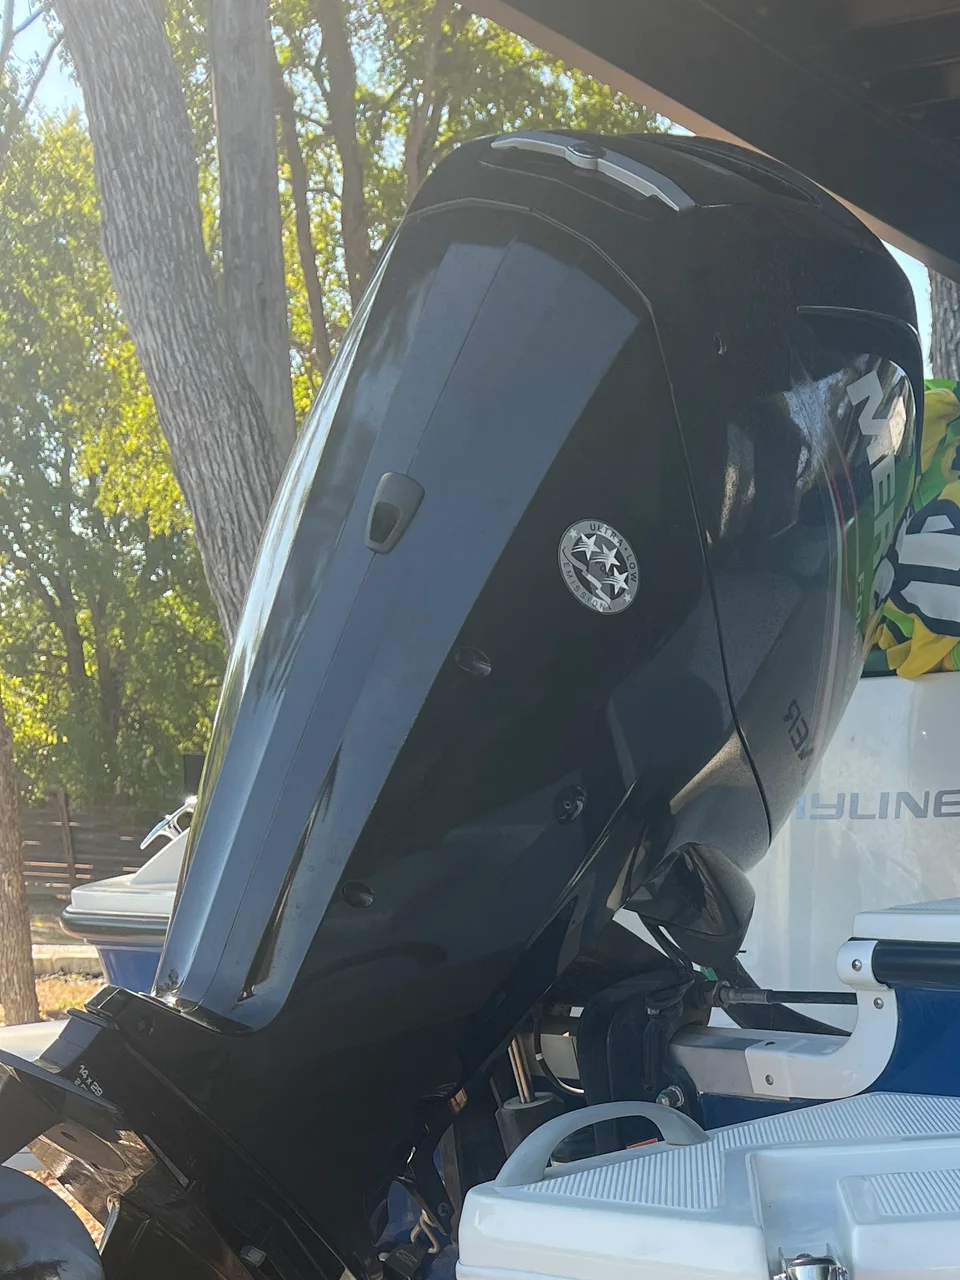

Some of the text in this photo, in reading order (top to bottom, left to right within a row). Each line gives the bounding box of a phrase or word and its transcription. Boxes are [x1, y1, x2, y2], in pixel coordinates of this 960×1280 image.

[589, 522, 624, 547] ULTRA
[626, 554, 637, 583] LOW
[563, 561, 606, 610] EMISSION
